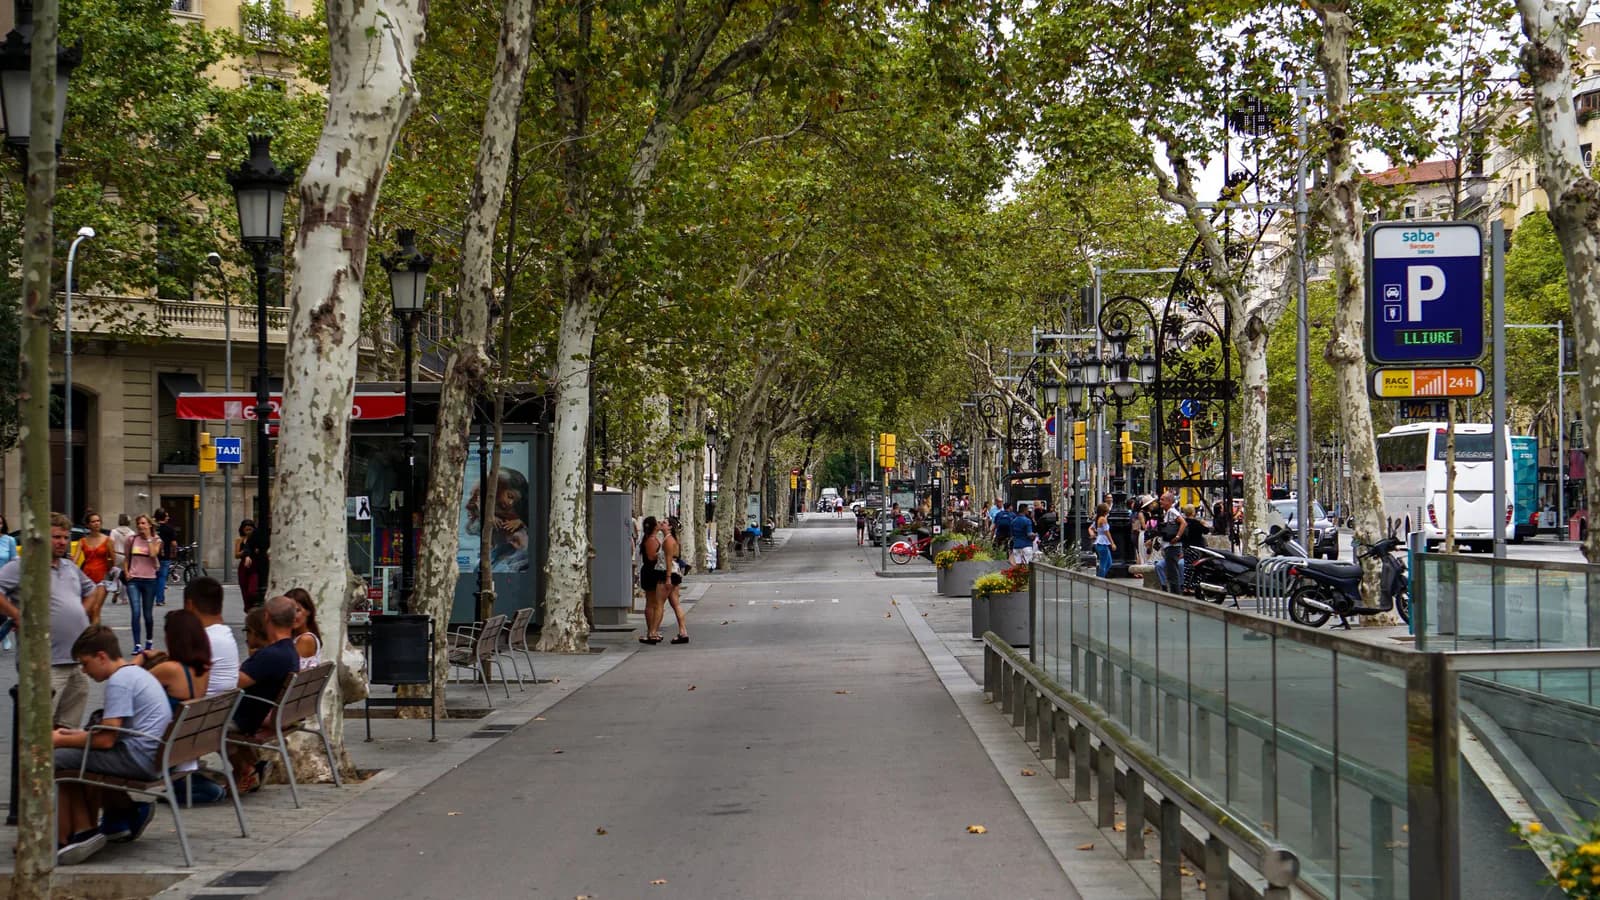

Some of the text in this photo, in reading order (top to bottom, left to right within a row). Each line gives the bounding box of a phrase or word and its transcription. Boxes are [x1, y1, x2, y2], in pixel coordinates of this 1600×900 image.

[1402, 229, 1435, 242] saba
[1407, 265, 1446, 322] P
[1385, 377, 1409, 385] RACC
[217, 446, 240, 455] TAXI
